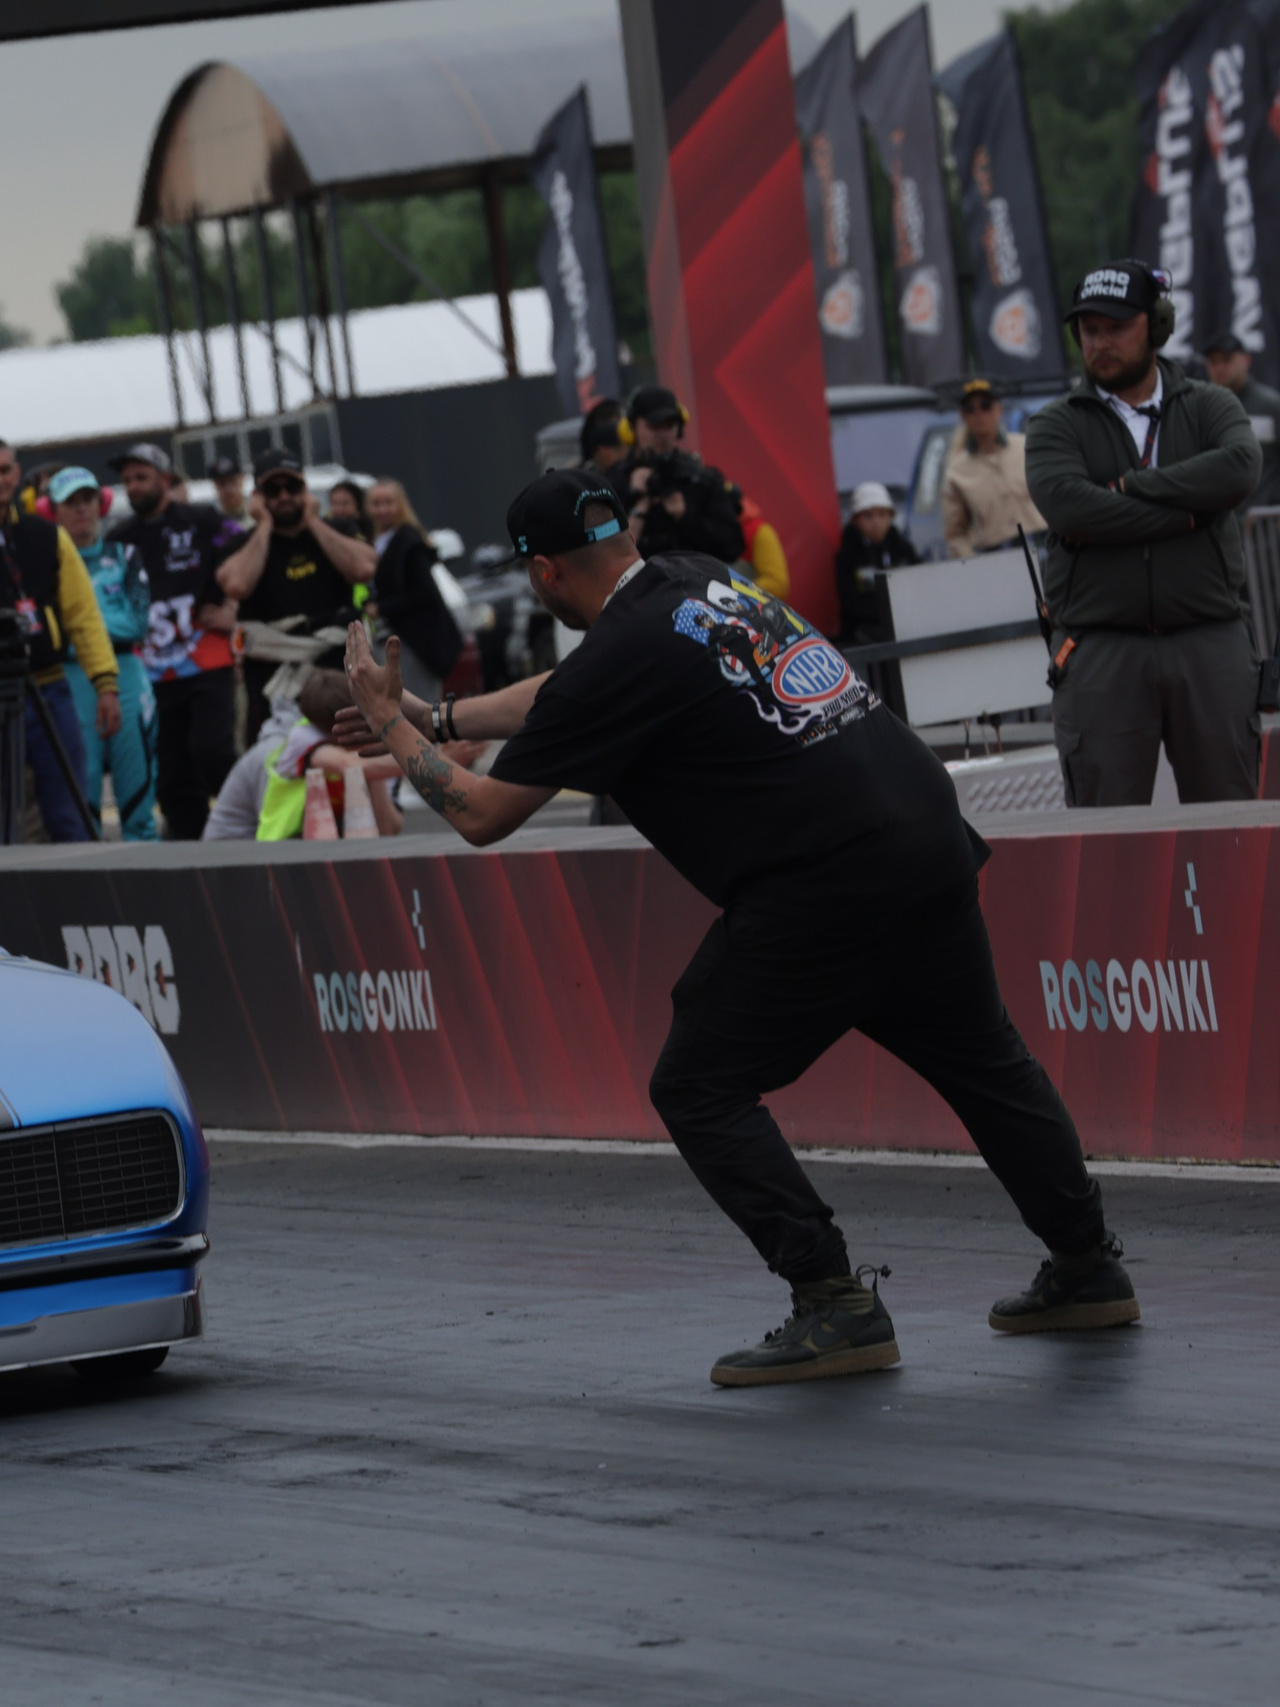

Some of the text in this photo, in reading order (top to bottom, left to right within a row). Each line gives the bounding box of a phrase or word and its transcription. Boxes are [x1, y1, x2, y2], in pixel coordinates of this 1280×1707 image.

[784, 645, 846, 696] NHRA
[313, 969, 438, 1034] ROSGONKI
[1038, 957, 1219, 1034] ROSGONKI
